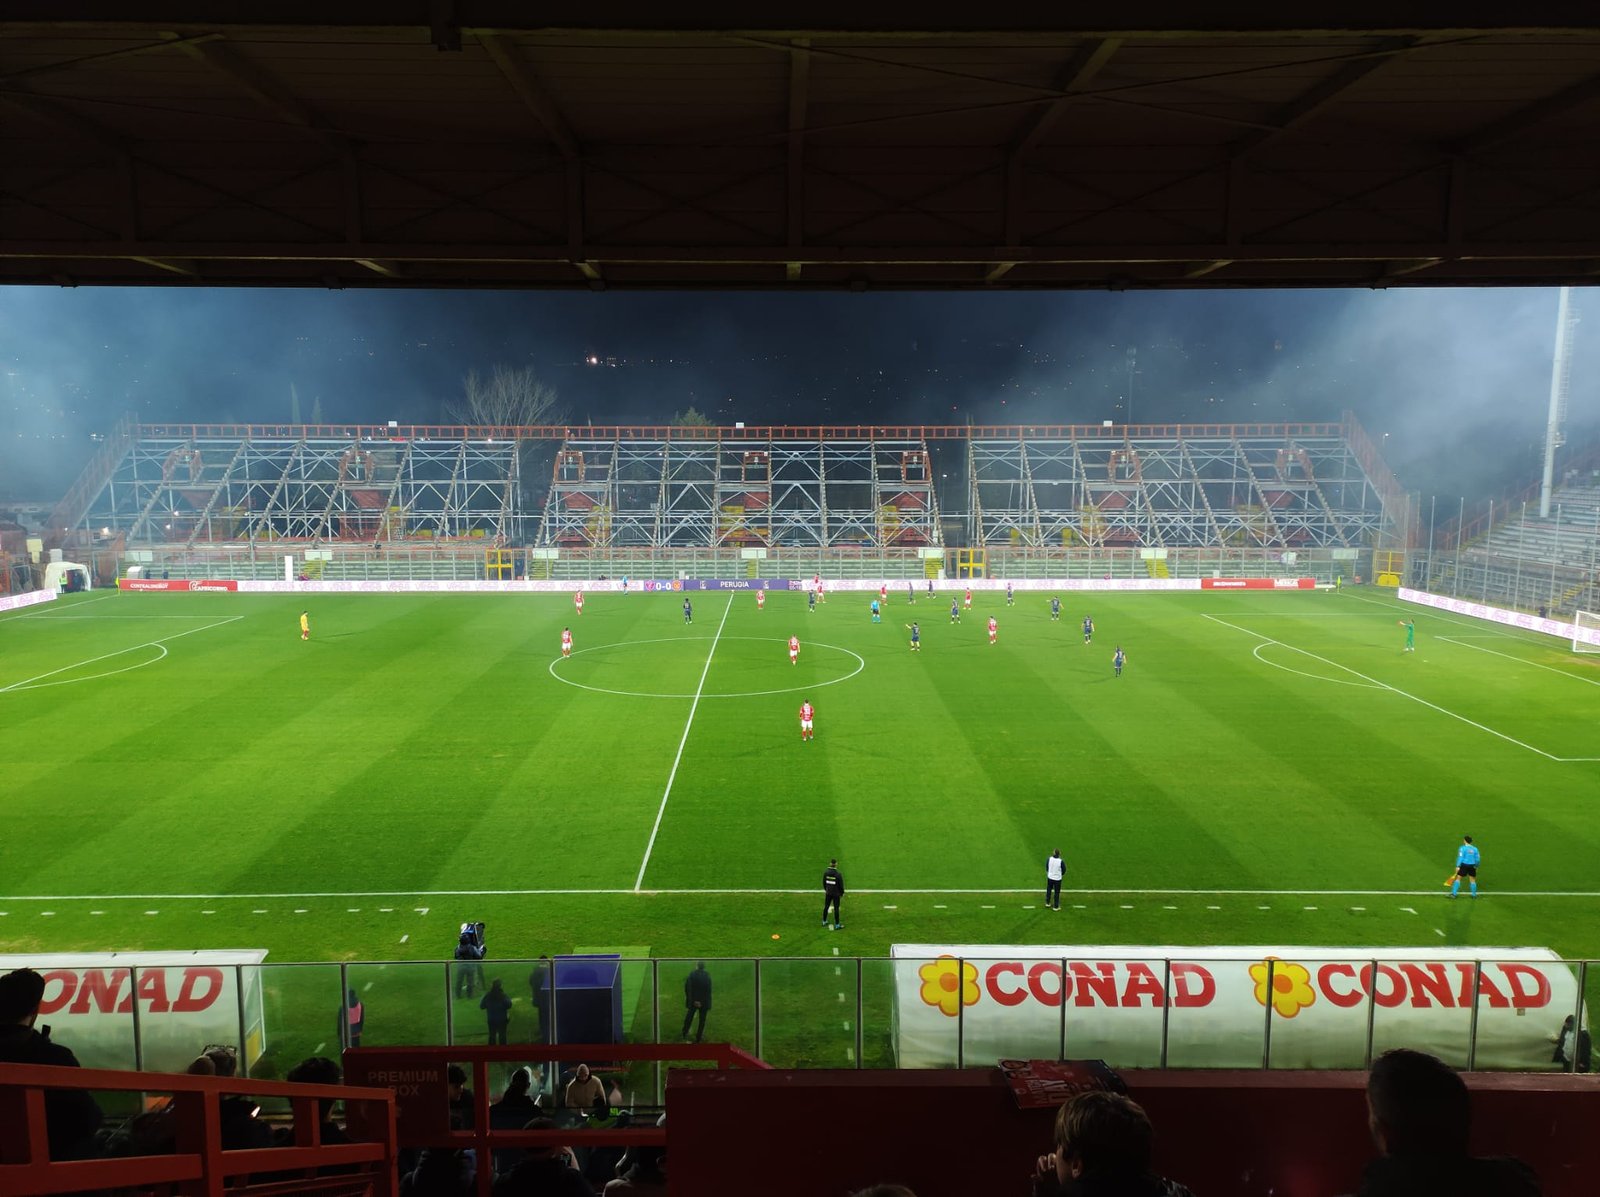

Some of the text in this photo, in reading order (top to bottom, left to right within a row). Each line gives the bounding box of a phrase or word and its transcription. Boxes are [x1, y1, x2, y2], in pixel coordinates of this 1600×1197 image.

[655, 582, 672, 590] 0-0
[38, 967, 223, 1015] ONAD
[985, 961, 1216, 1008] CONAD
[1317, 963, 1552, 1009] CONAD
[368, 1070, 438, 1082] PREMIUM
